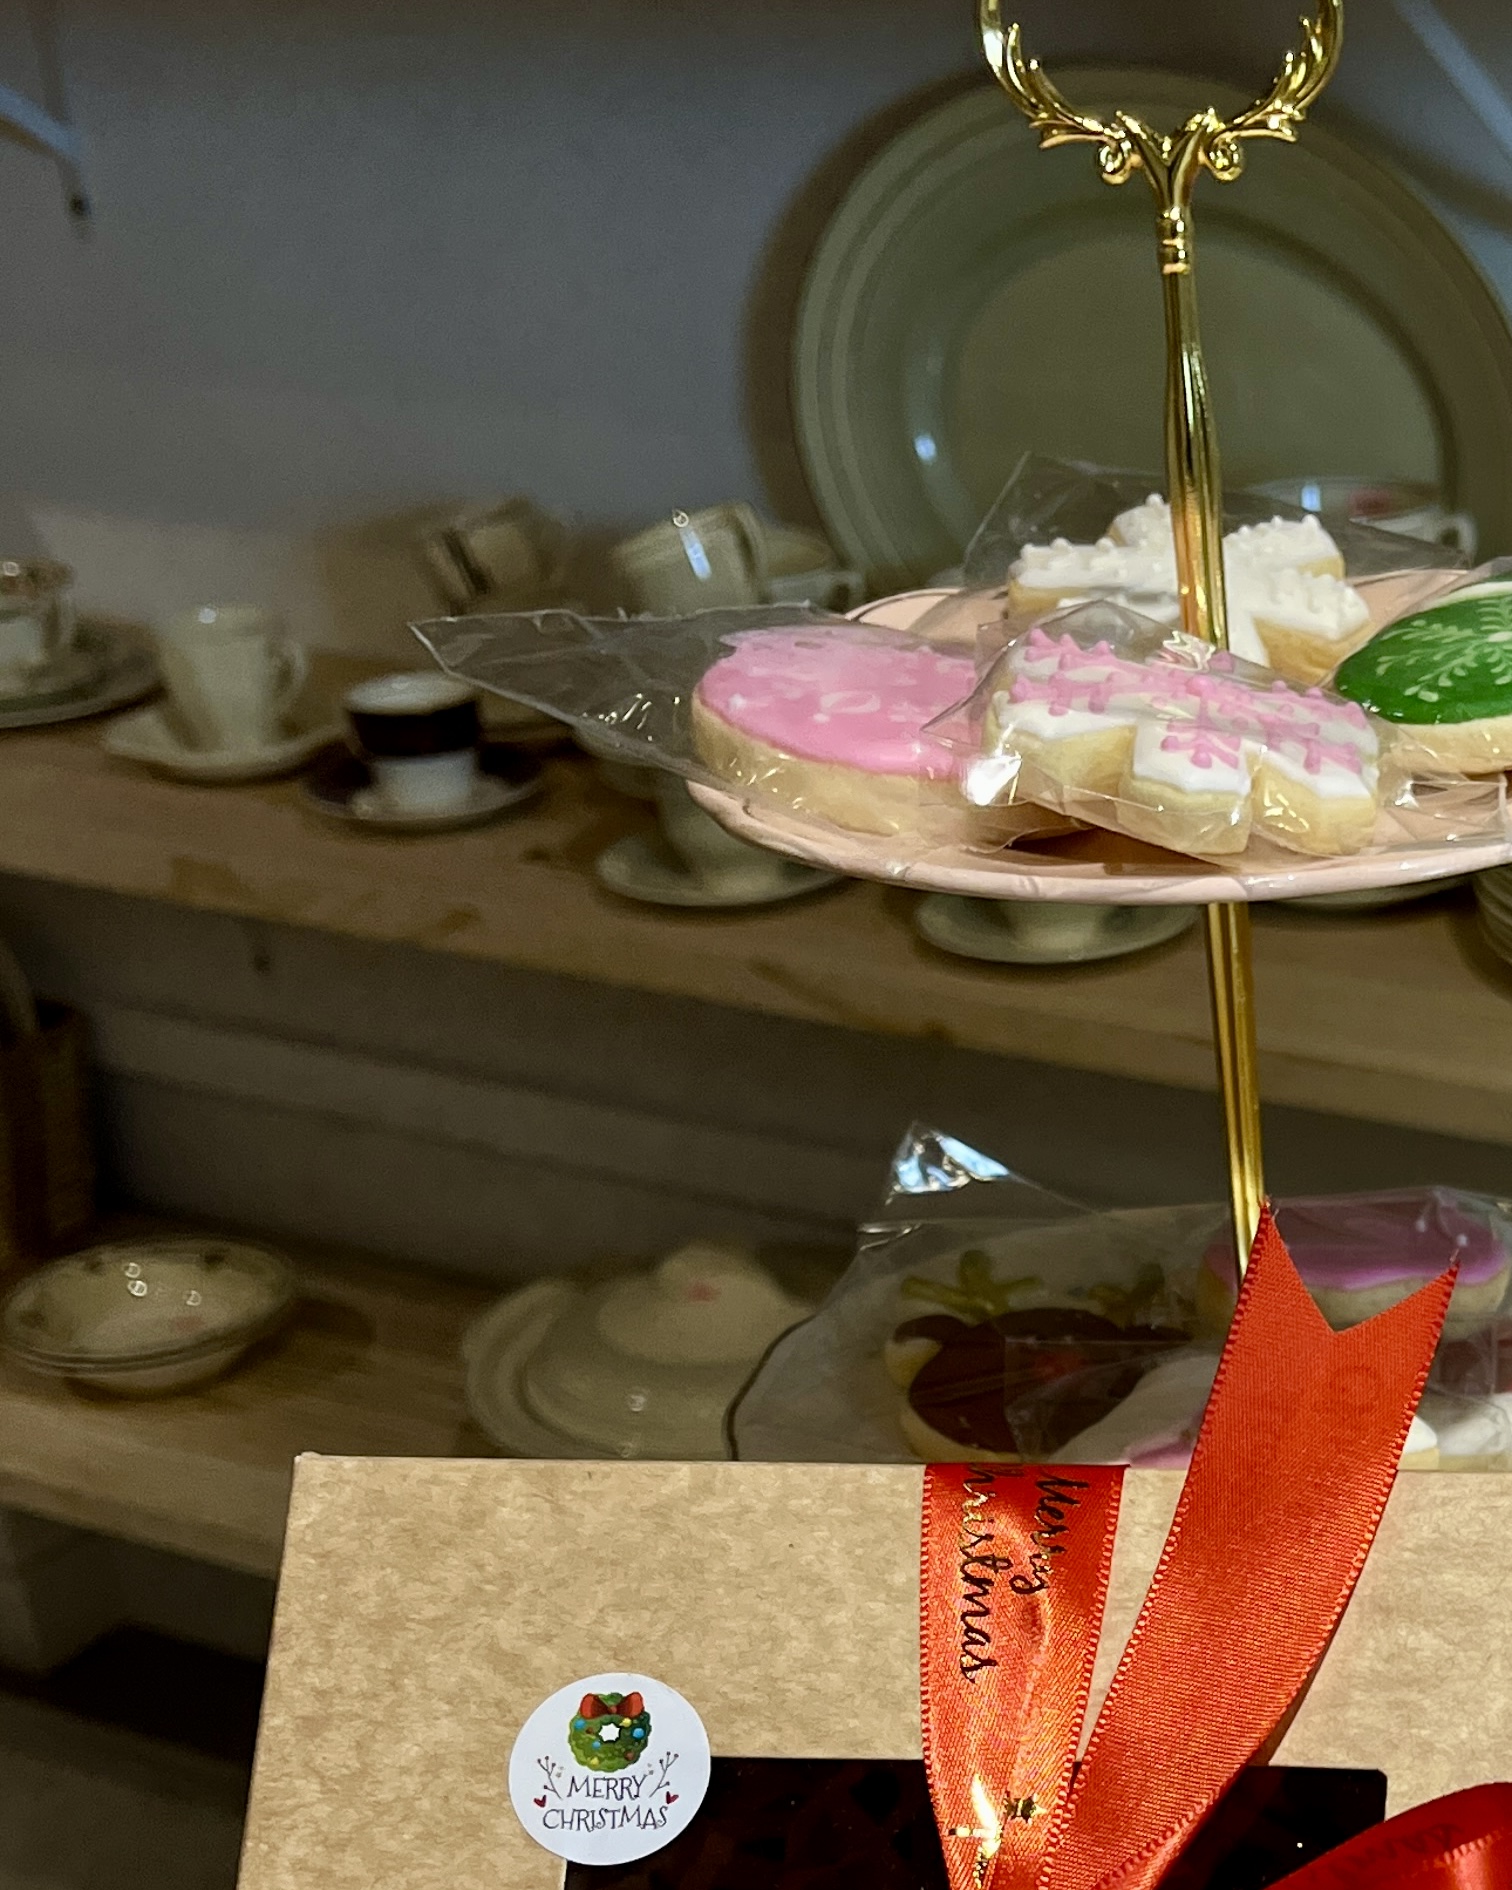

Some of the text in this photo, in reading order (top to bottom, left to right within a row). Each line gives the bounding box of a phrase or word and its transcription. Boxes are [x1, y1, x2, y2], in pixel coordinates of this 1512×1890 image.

[1009, 1470, 1090, 1595] Merry
[958, 1463, 1024, 1684] hristmas
[543, 1805, 668, 1833] CHRISTMAS
[566, 1775, 648, 1801] MERRY
